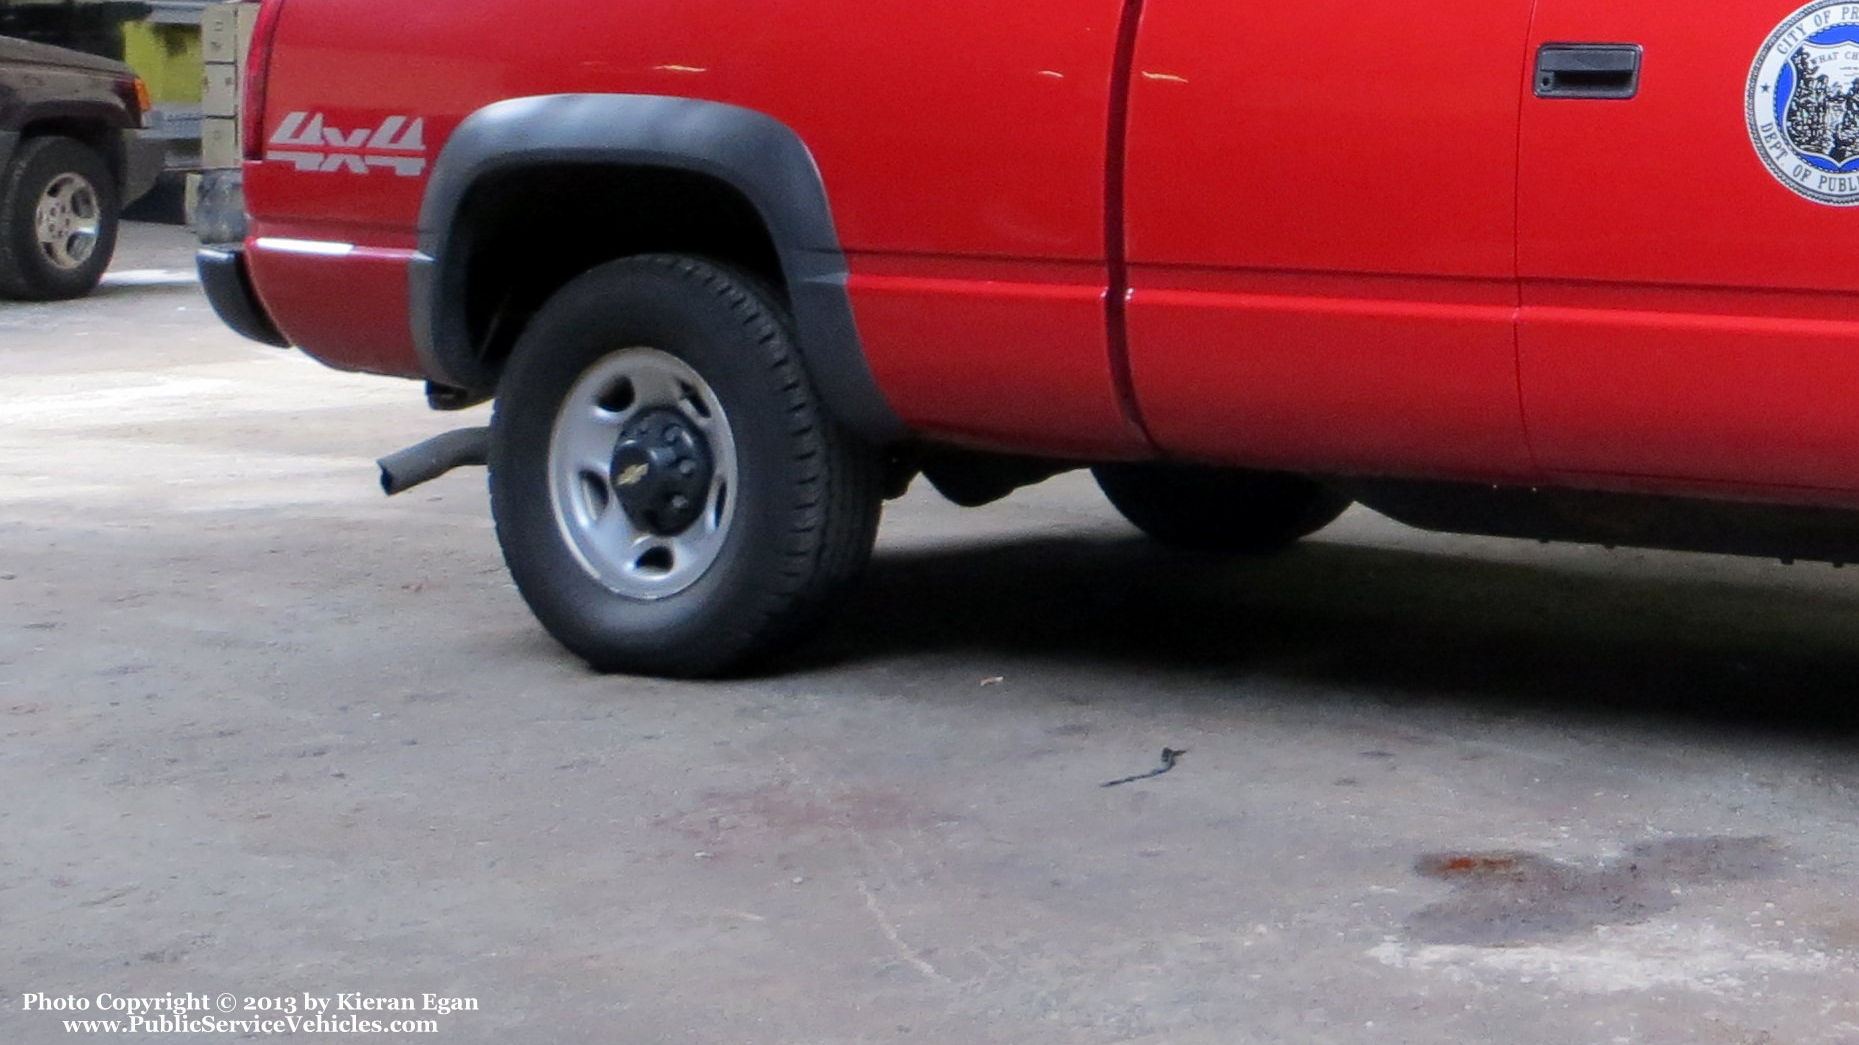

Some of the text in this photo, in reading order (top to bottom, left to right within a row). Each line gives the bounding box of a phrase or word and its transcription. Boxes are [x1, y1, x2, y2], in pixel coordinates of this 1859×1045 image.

[1776, 23, 1807, 55] CITY
[1813, 9, 1831, 27] OF
[1792, 164, 1812, 182] OF
